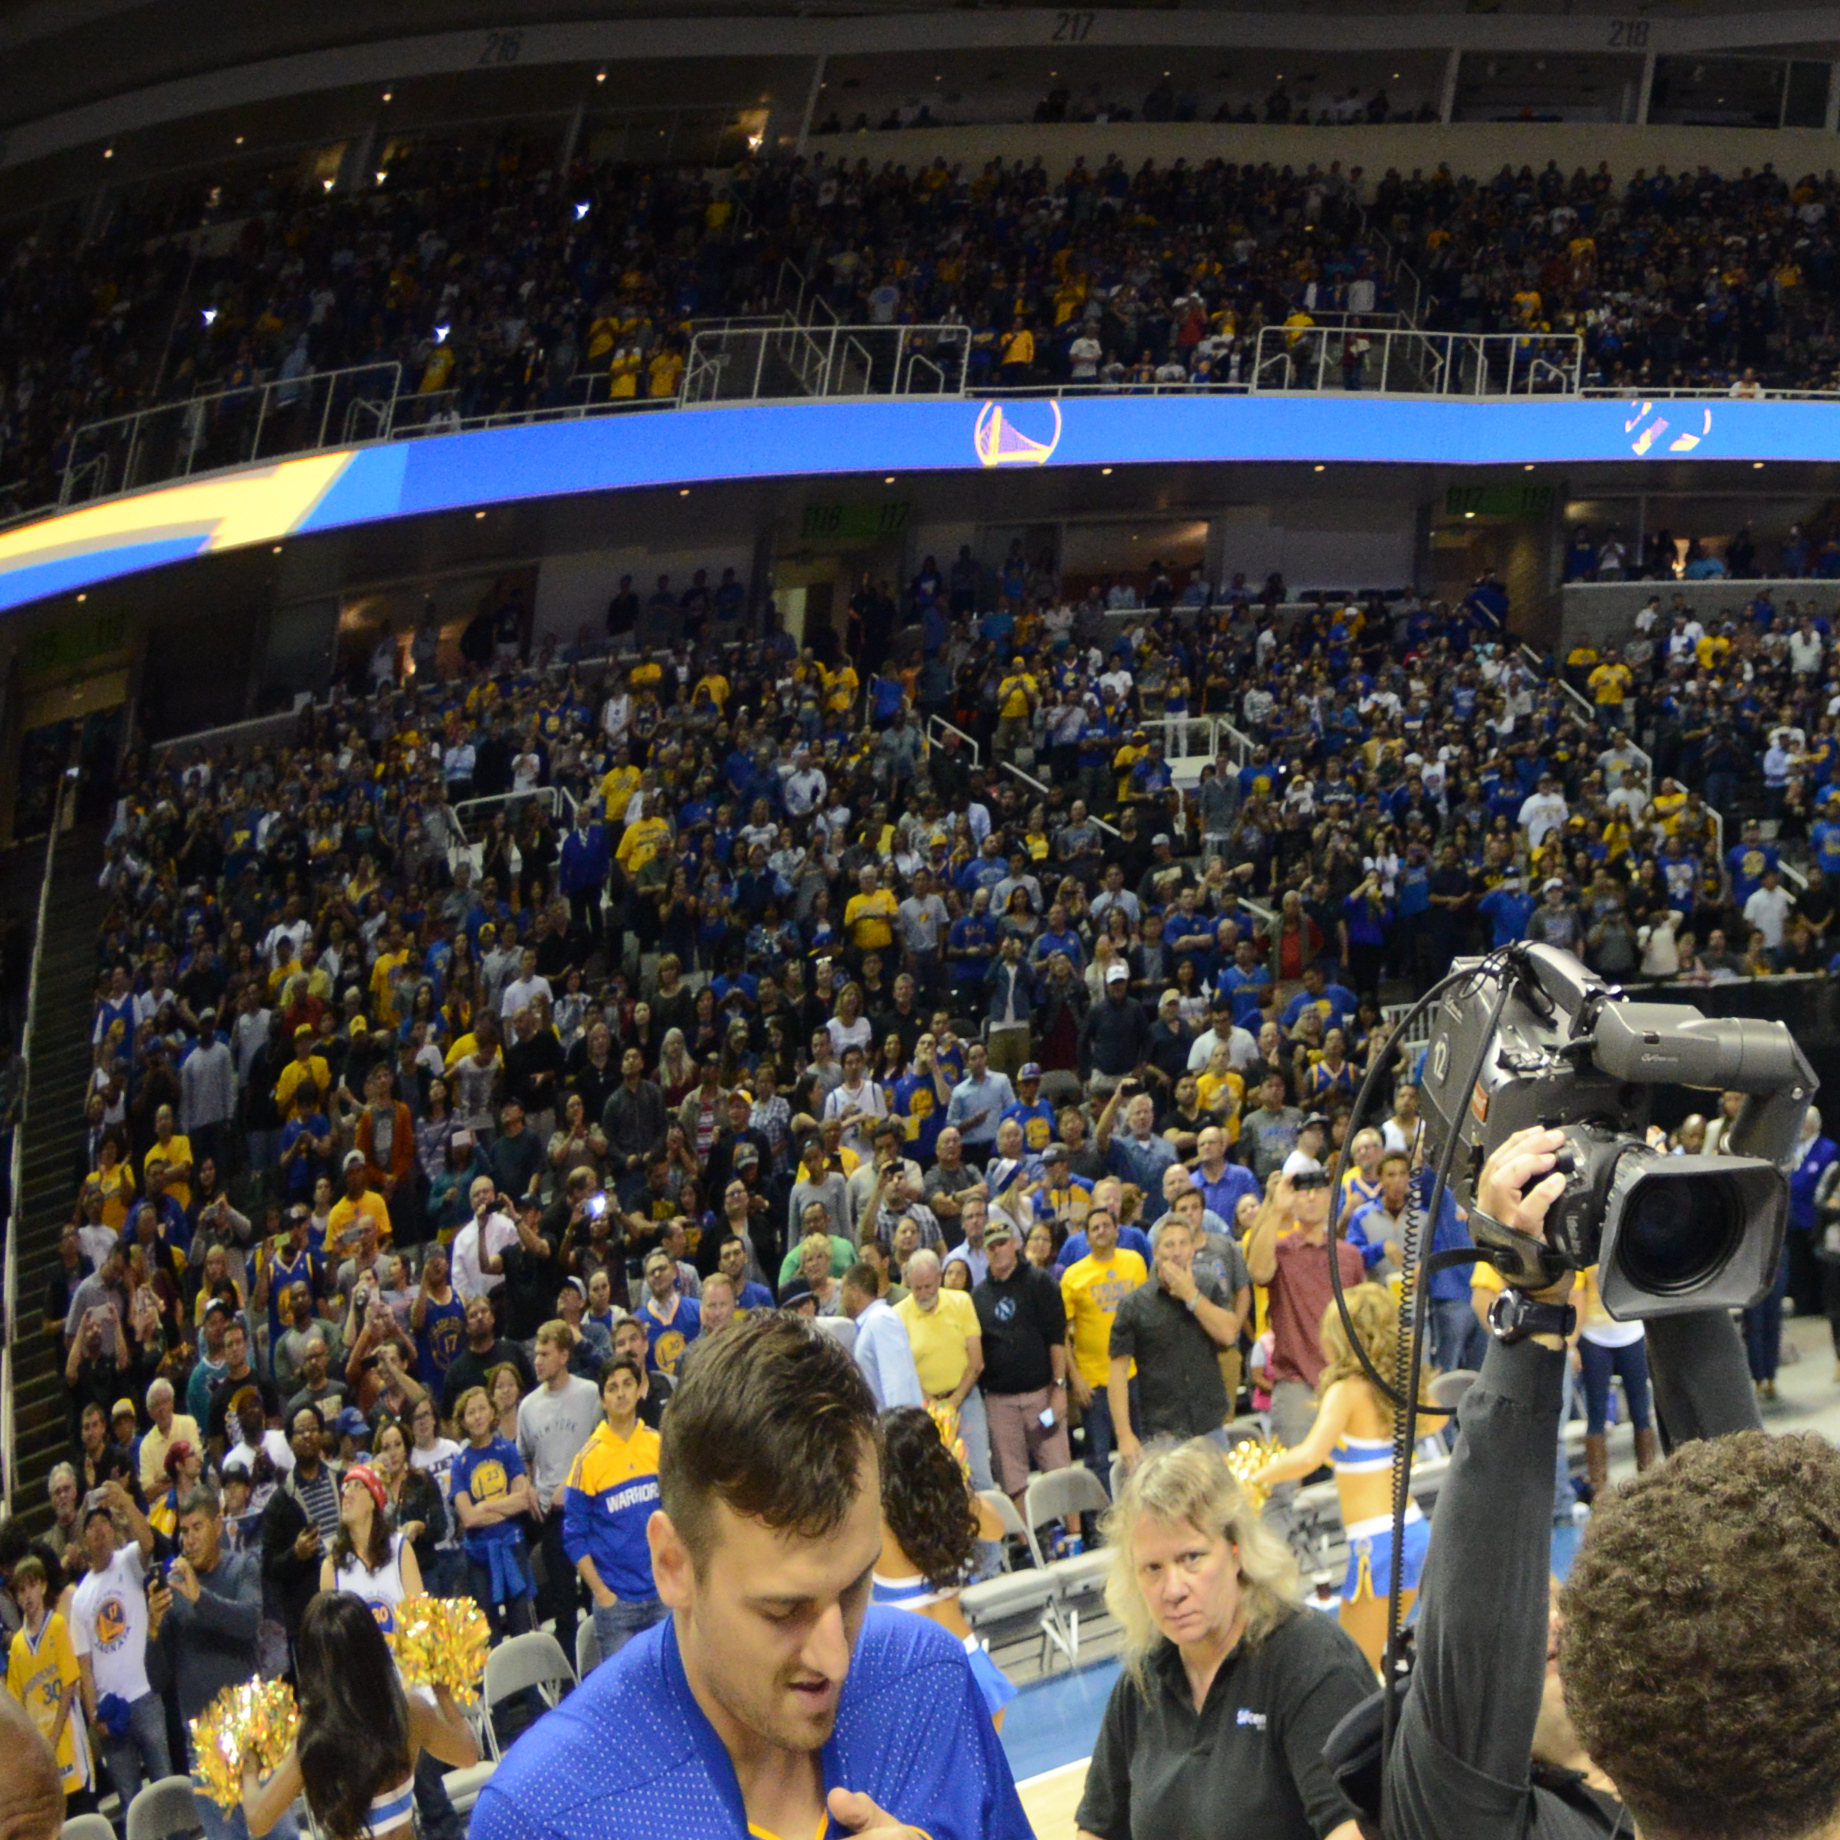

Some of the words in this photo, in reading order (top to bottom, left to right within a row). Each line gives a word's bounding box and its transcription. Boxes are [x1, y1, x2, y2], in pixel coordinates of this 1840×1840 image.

[1052, 12, 1094, 42] 217
[1608, 20, 1649, 48] 218
[606, 1481, 659, 1514] WARRIOR
